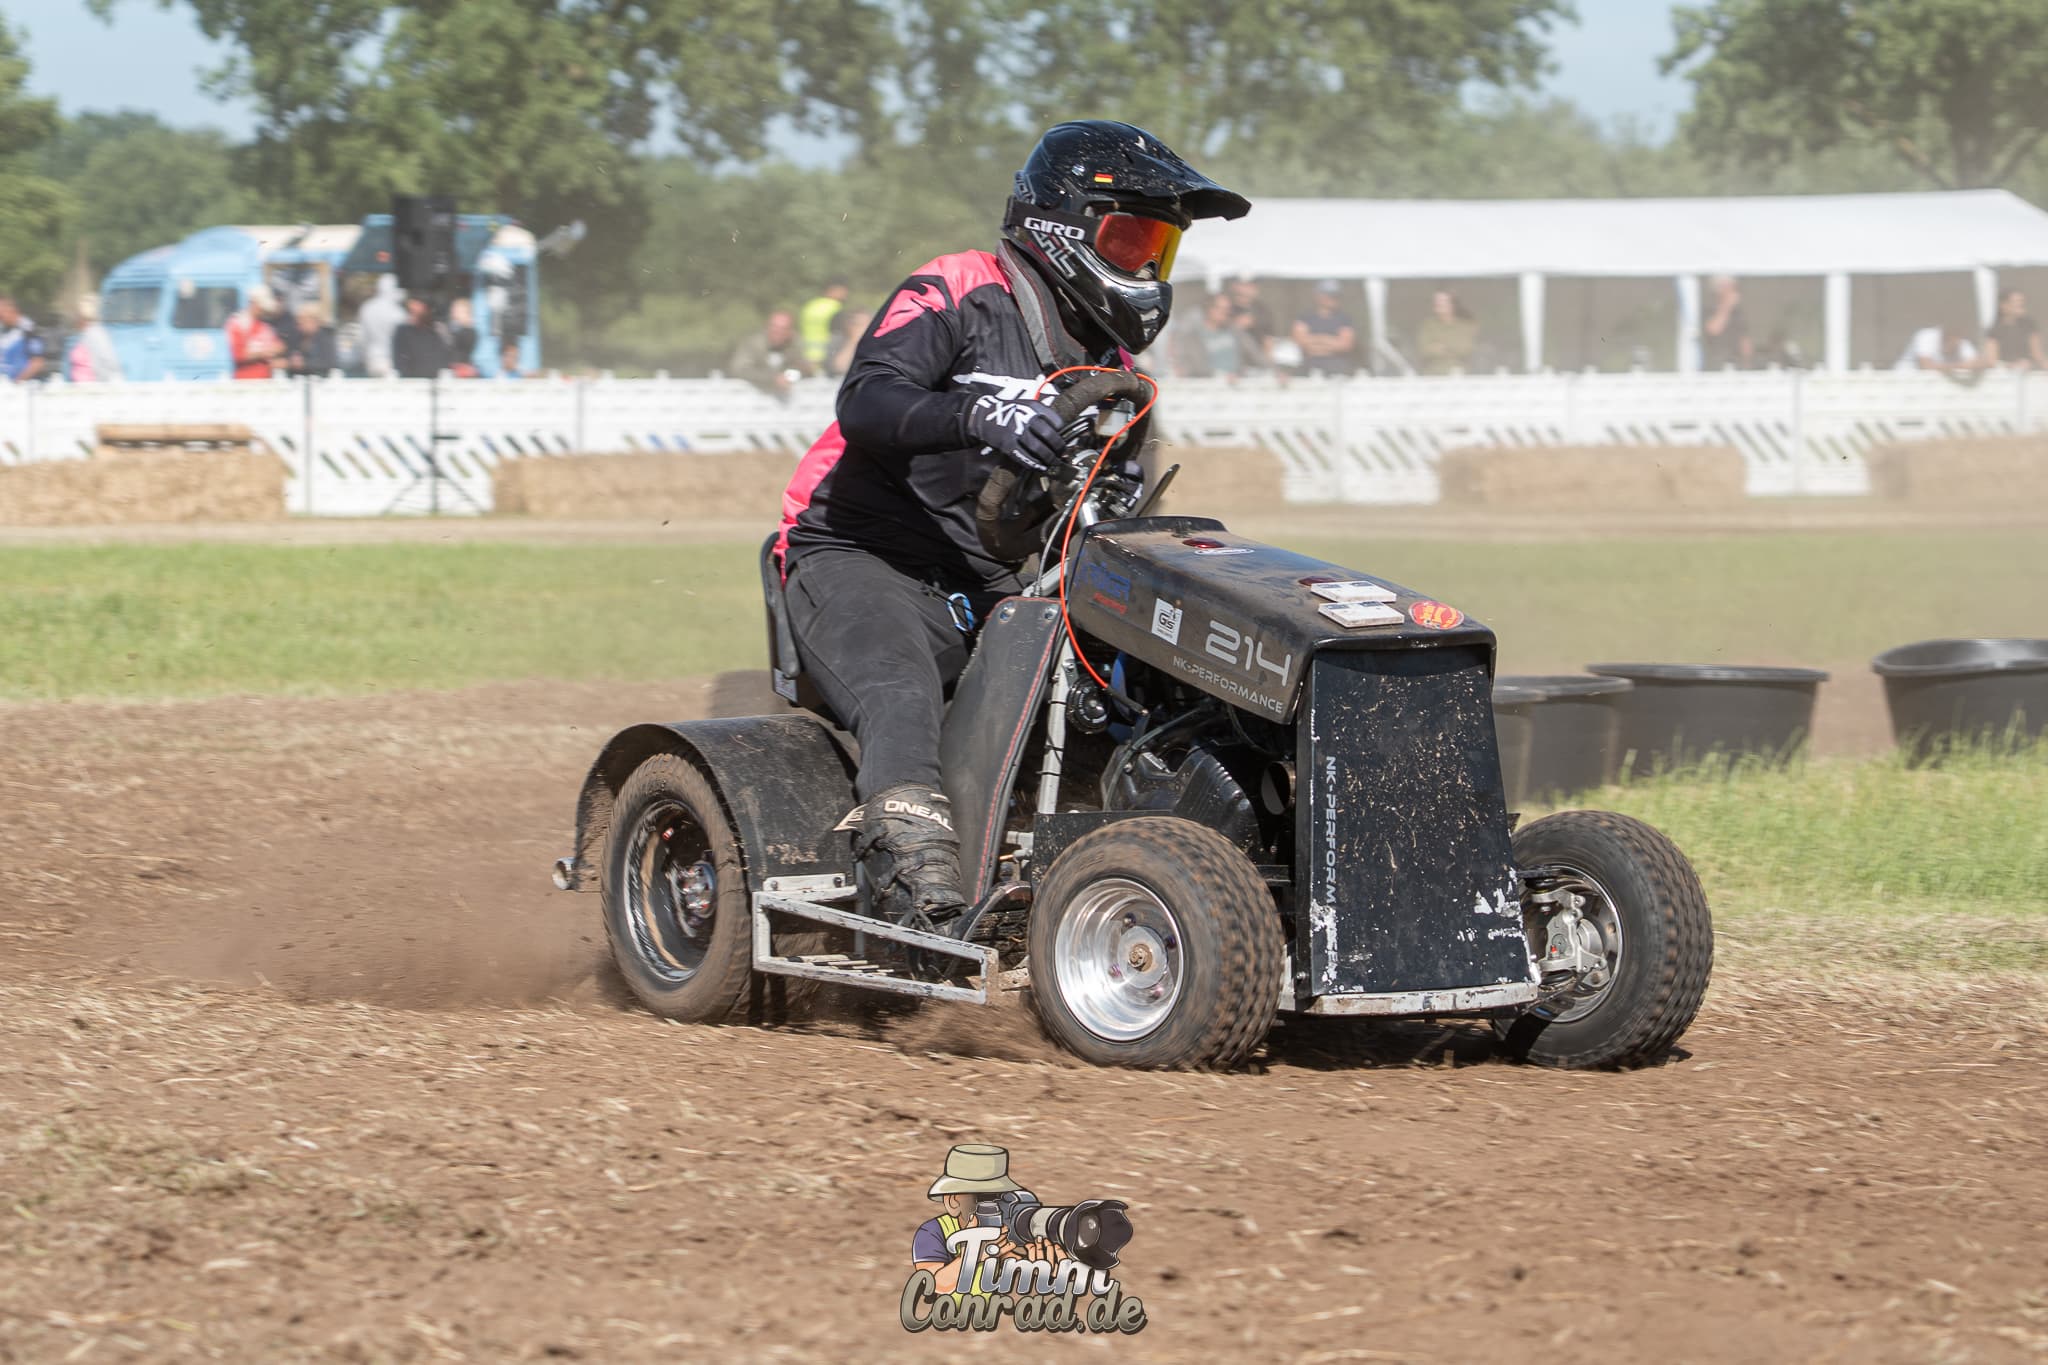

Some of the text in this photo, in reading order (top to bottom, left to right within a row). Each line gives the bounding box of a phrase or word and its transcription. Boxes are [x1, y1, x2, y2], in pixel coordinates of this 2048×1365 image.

[1023, 217, 1086, 241] GIRO
[1205, 619, 1291, 687] 214
[1172, 655, 1285, 714] NK-PERFORMANCE
